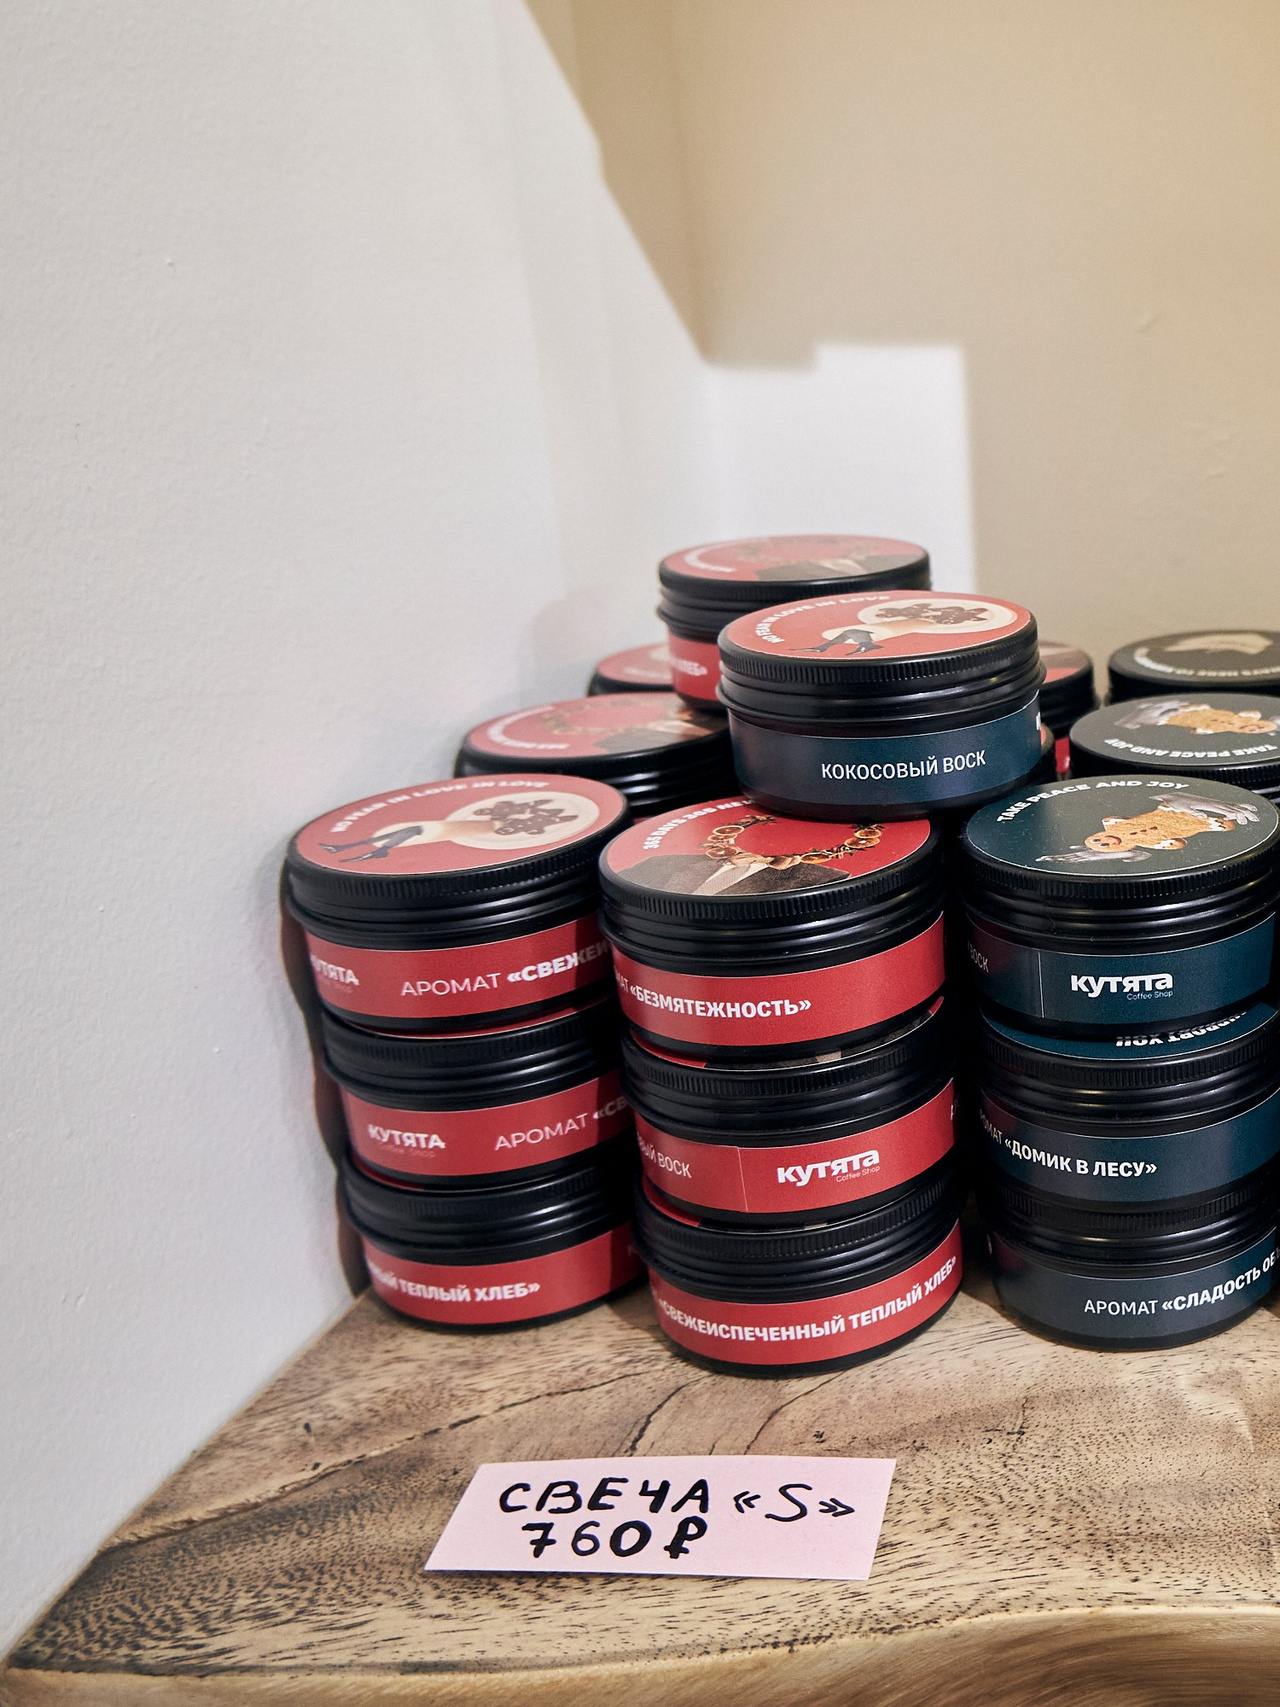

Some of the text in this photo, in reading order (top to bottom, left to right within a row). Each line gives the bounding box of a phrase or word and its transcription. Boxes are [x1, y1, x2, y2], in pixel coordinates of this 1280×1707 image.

[776, 604, 815, 618] LOVE
[839, 596, 890, 604] LOVE
[1104, 738, 1278, 759] TAKE PEACE AND JOY
[821, 749, 986, 781] КОКОСОВЫЙ ВОСК
[387, 793, 411, 805] IN
[412, 783, 470, 798] LOVE
[498, 780, 550, 789] LOVE
[997, 780, 1189, 822] TAKE PEACE AND JOY
[650, 818, 687, 837] DAYS
[682, 807, 717, 820] 365
[401, 972, 501, 997] АРОМАТ
[1126, 990, 1175, 1001] Coffee Shop
[630, 984, 812, 1018] «БЕЗМЯТЕЖНОСТЬ»
[368, 1124, 447, 1149] КУТЯТА
[494, 1112, 589, 1151] АРОМАТ
[657, 1152, 692, 1179] ВОСК
[1004, 1137, 1072, 1173] «ДОМИК
[1076, 1159, 1089, 1174] В
[1092, 1161, 1157, 1178] ЛЕСУ»
[836, 1164, 882, 1184] Coffee Shop
[398, 1277, 471, 1302] ТЕПЛЫЙ
[474, 1281, 541, 1302] ХЛЕБ»
[658, 1254, 958, 1343] «СВЕЖЕИСПЕЧЕННЫЙ ТЕПЛЫЙ ХЛЕБ»
[1084, 1298, 1158, 1316] АРОМАТ
[1161, 1266, 1262, 1312] «СЛАДОСТЬ
[499, 1477, 856, 1523] СВЕЧА «S»
